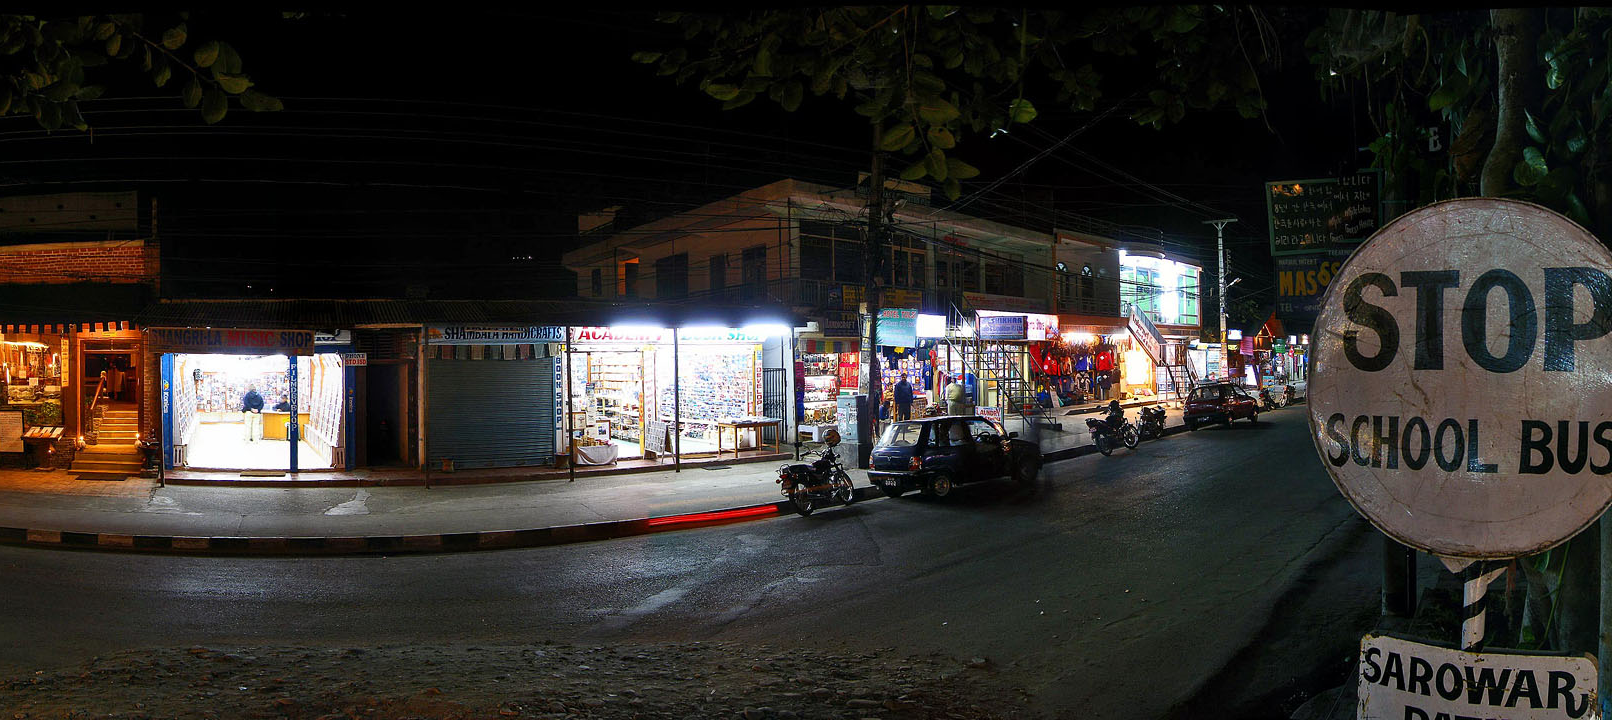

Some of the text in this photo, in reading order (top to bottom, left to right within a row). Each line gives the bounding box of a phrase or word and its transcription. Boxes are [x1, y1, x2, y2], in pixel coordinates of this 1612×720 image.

[151, 330, 314, 349] SHANGRI-LA MUSIC SHOP
[444, 326, 563, 341] SHAMBALA HANDICRAFTS
[555, 392, 563, 424] SHOP
[1327, 412, 1498, 473] SCHOOL
[1363, 646, 1589, 720] SAROWAR
